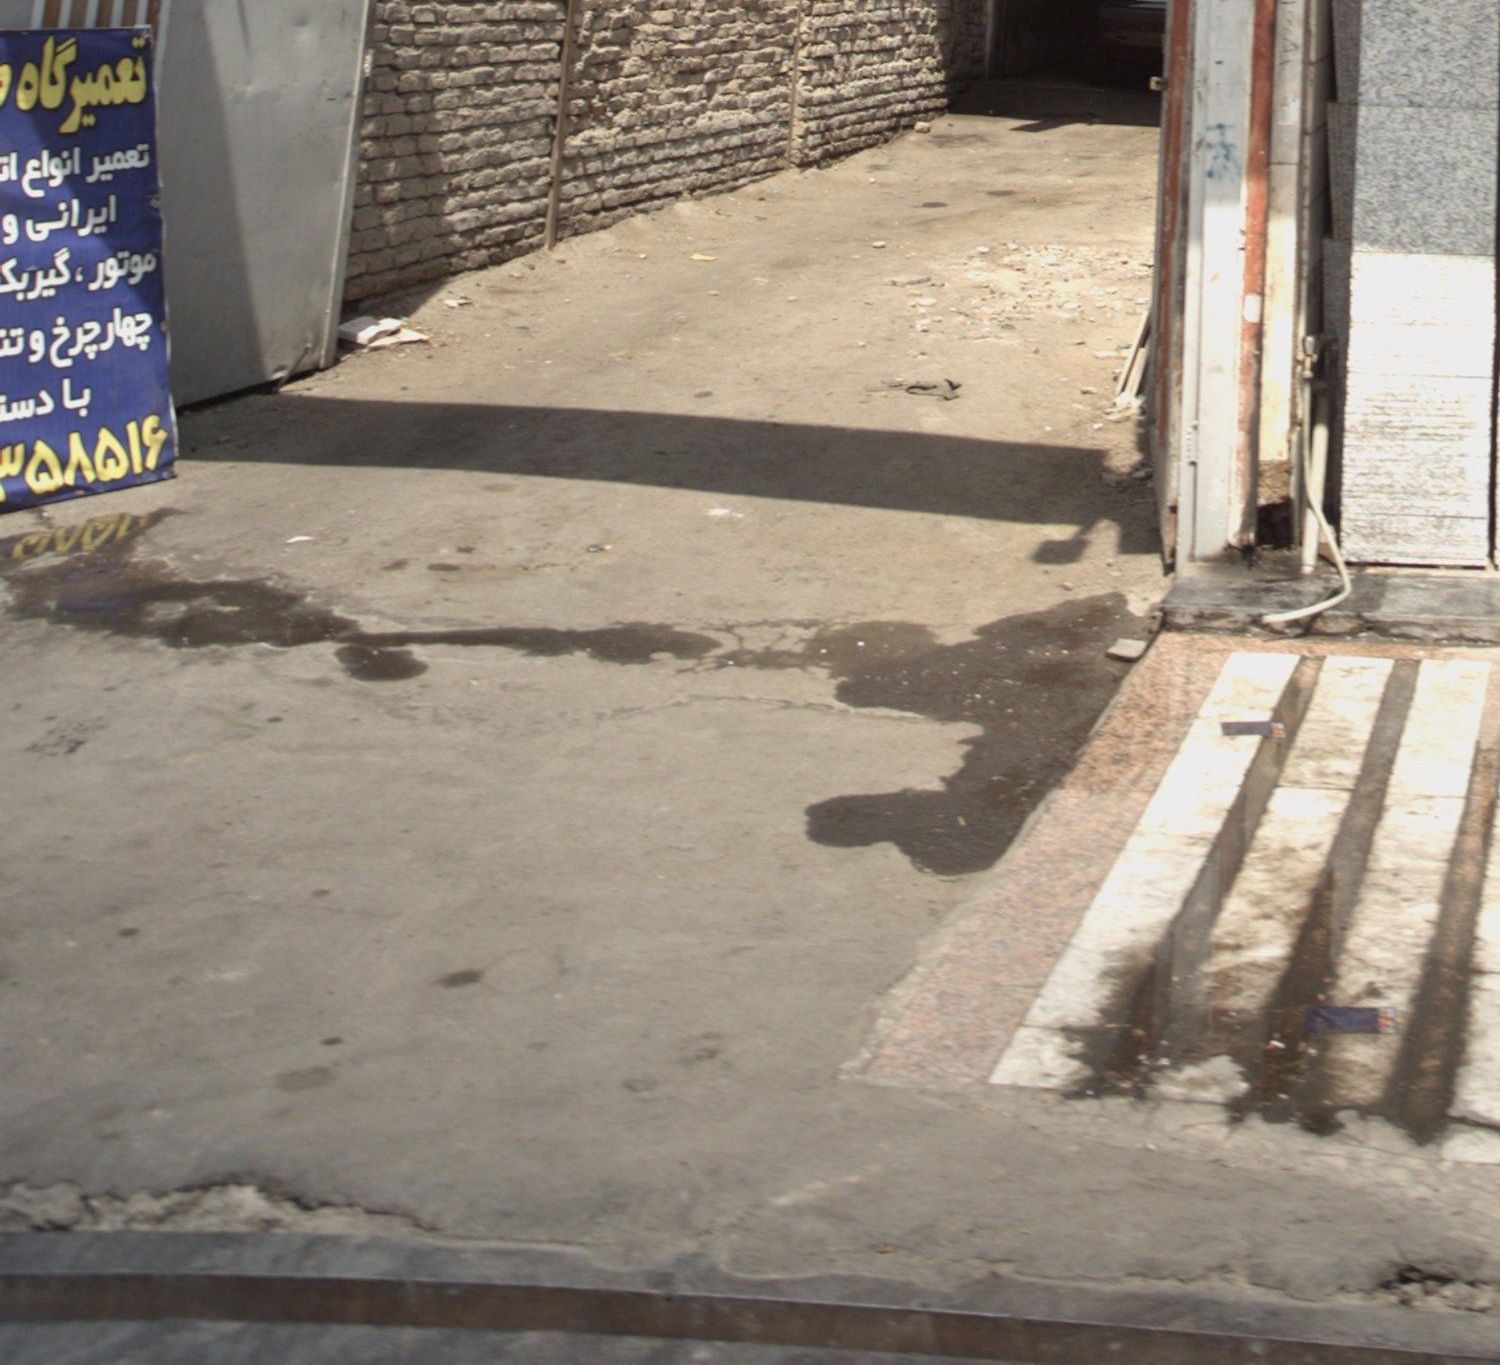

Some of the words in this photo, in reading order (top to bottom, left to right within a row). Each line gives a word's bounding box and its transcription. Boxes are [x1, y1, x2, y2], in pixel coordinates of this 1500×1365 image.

[21, 146, 81, 198] انواع
[85, 143, 150, 184] تعمیر
[2, 213, 19, 245] و
[25, 194, 117, 242] ایرانی
[28, 329, 46, 363] و
[62, 377, 92, 417] با
